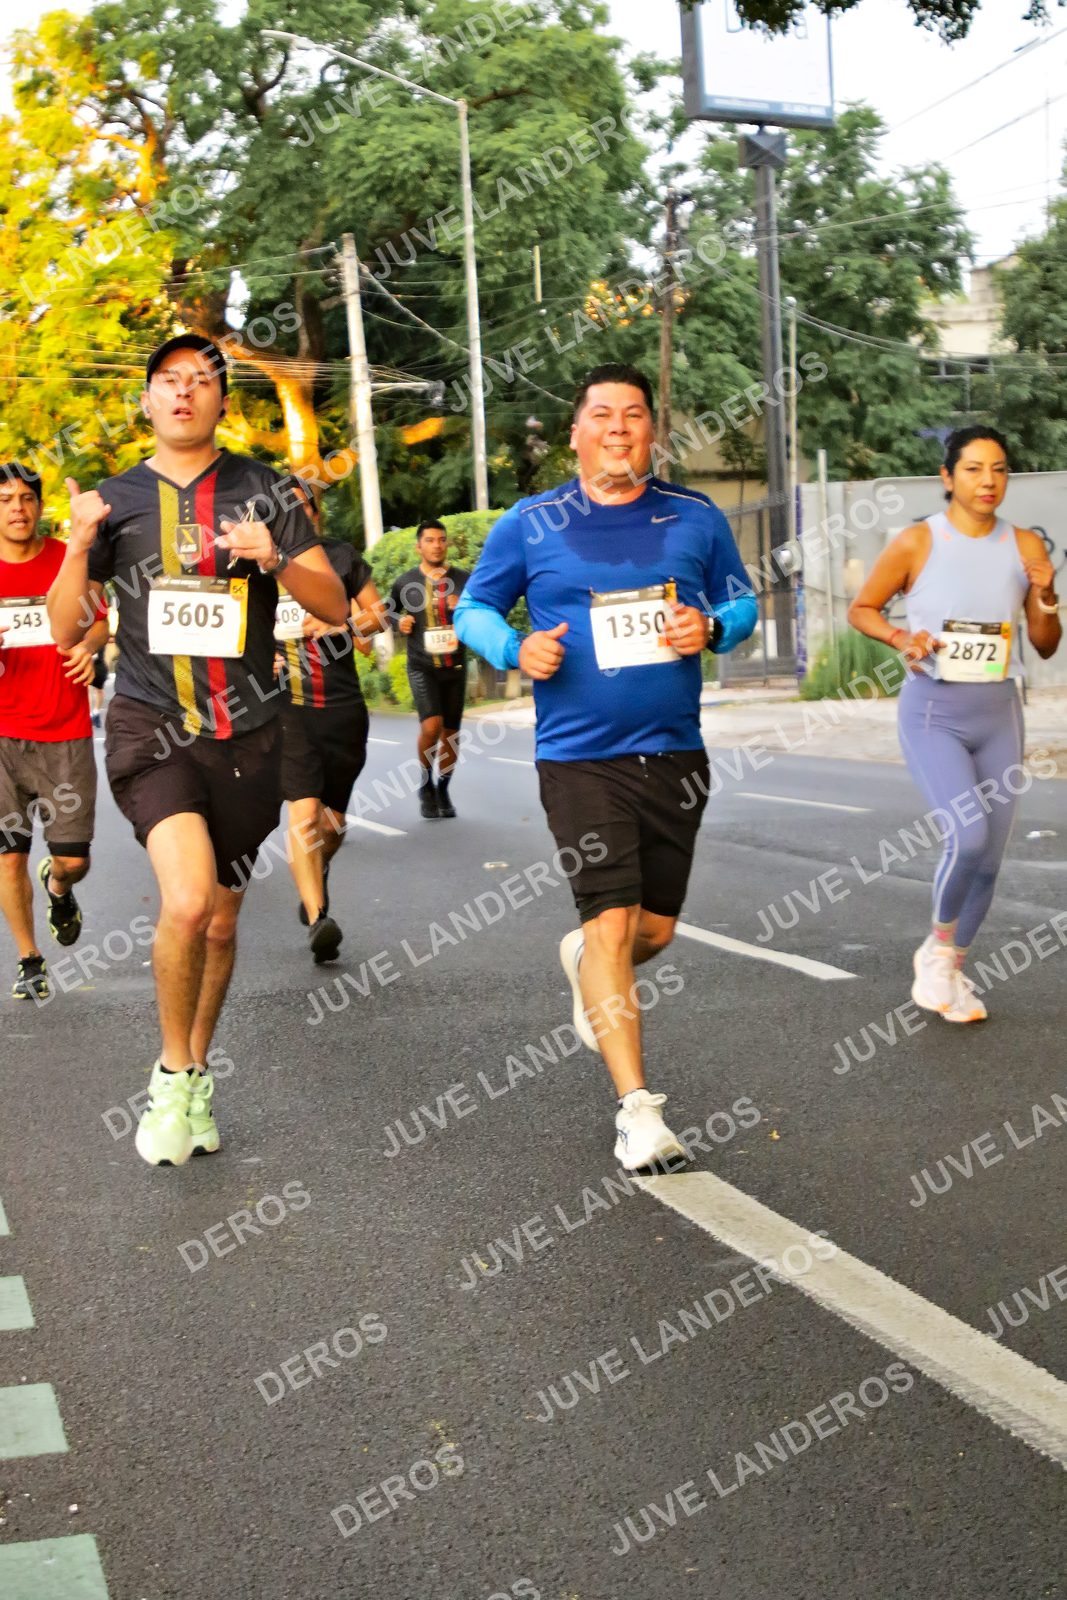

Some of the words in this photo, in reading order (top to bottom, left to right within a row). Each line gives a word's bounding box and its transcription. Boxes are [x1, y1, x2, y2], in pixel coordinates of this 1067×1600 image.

[13, 612, 42, 630] 543
[161, 601, 225, 629] 5605
[606, 610, 666, 639] 1350
[949, 640, 997, 662] 2872
